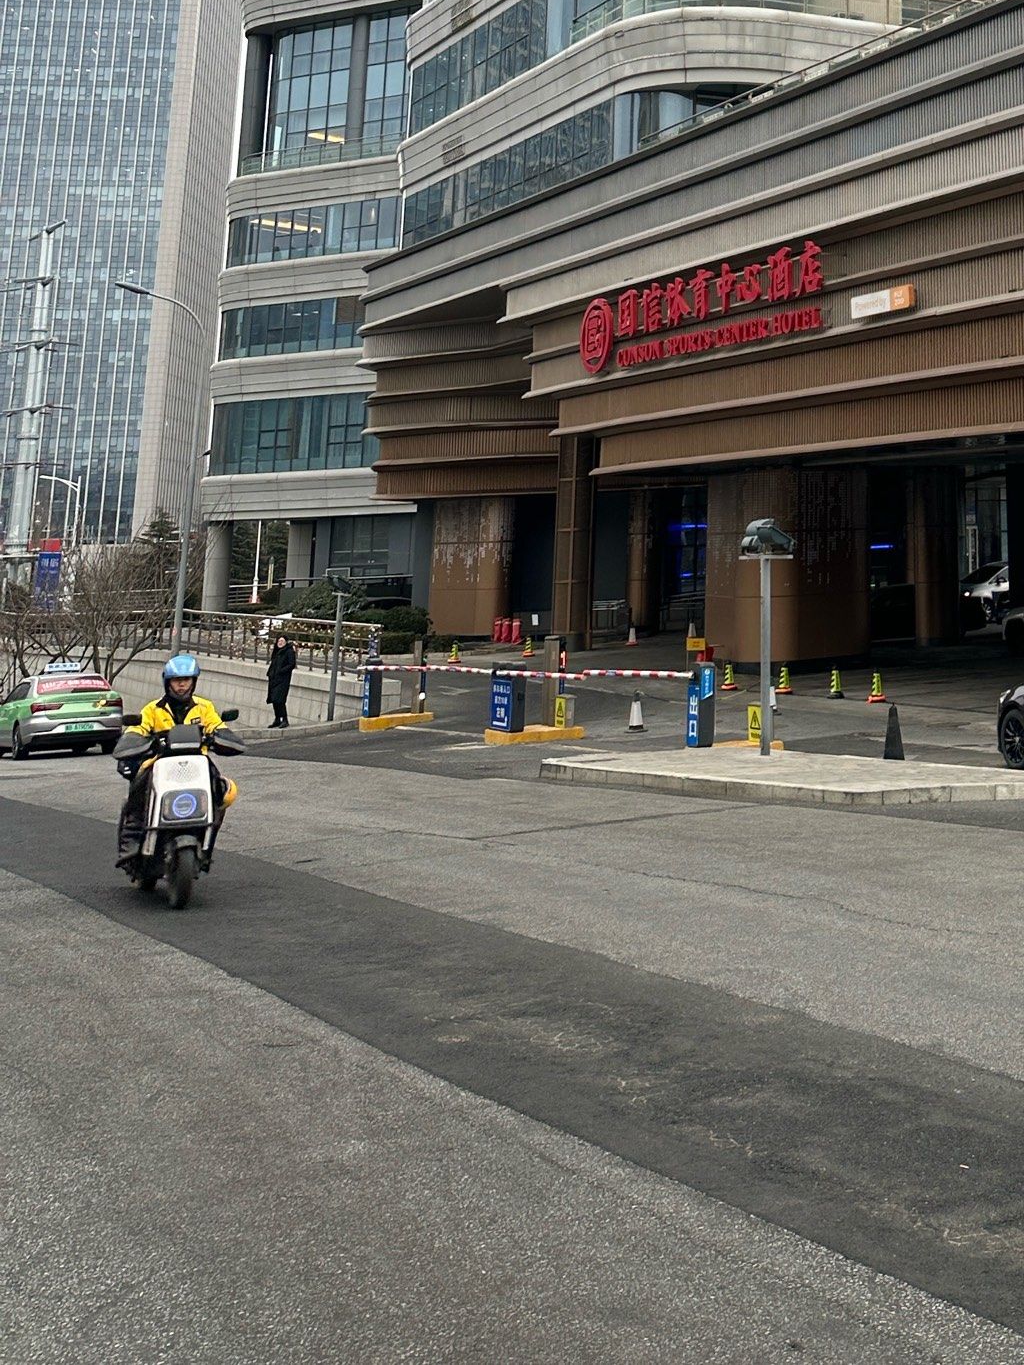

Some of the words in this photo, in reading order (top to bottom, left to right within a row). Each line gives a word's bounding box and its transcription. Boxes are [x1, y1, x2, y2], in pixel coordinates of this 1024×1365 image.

[618, 240, 824, 337] 国信体育中心酒店
[617, 340, 664, 367] CONSON
[664, 328, 714, 357] SPORTS
[715, 318, 769, 347] CENTER
[772, 306, 823, 336] HOTEL
